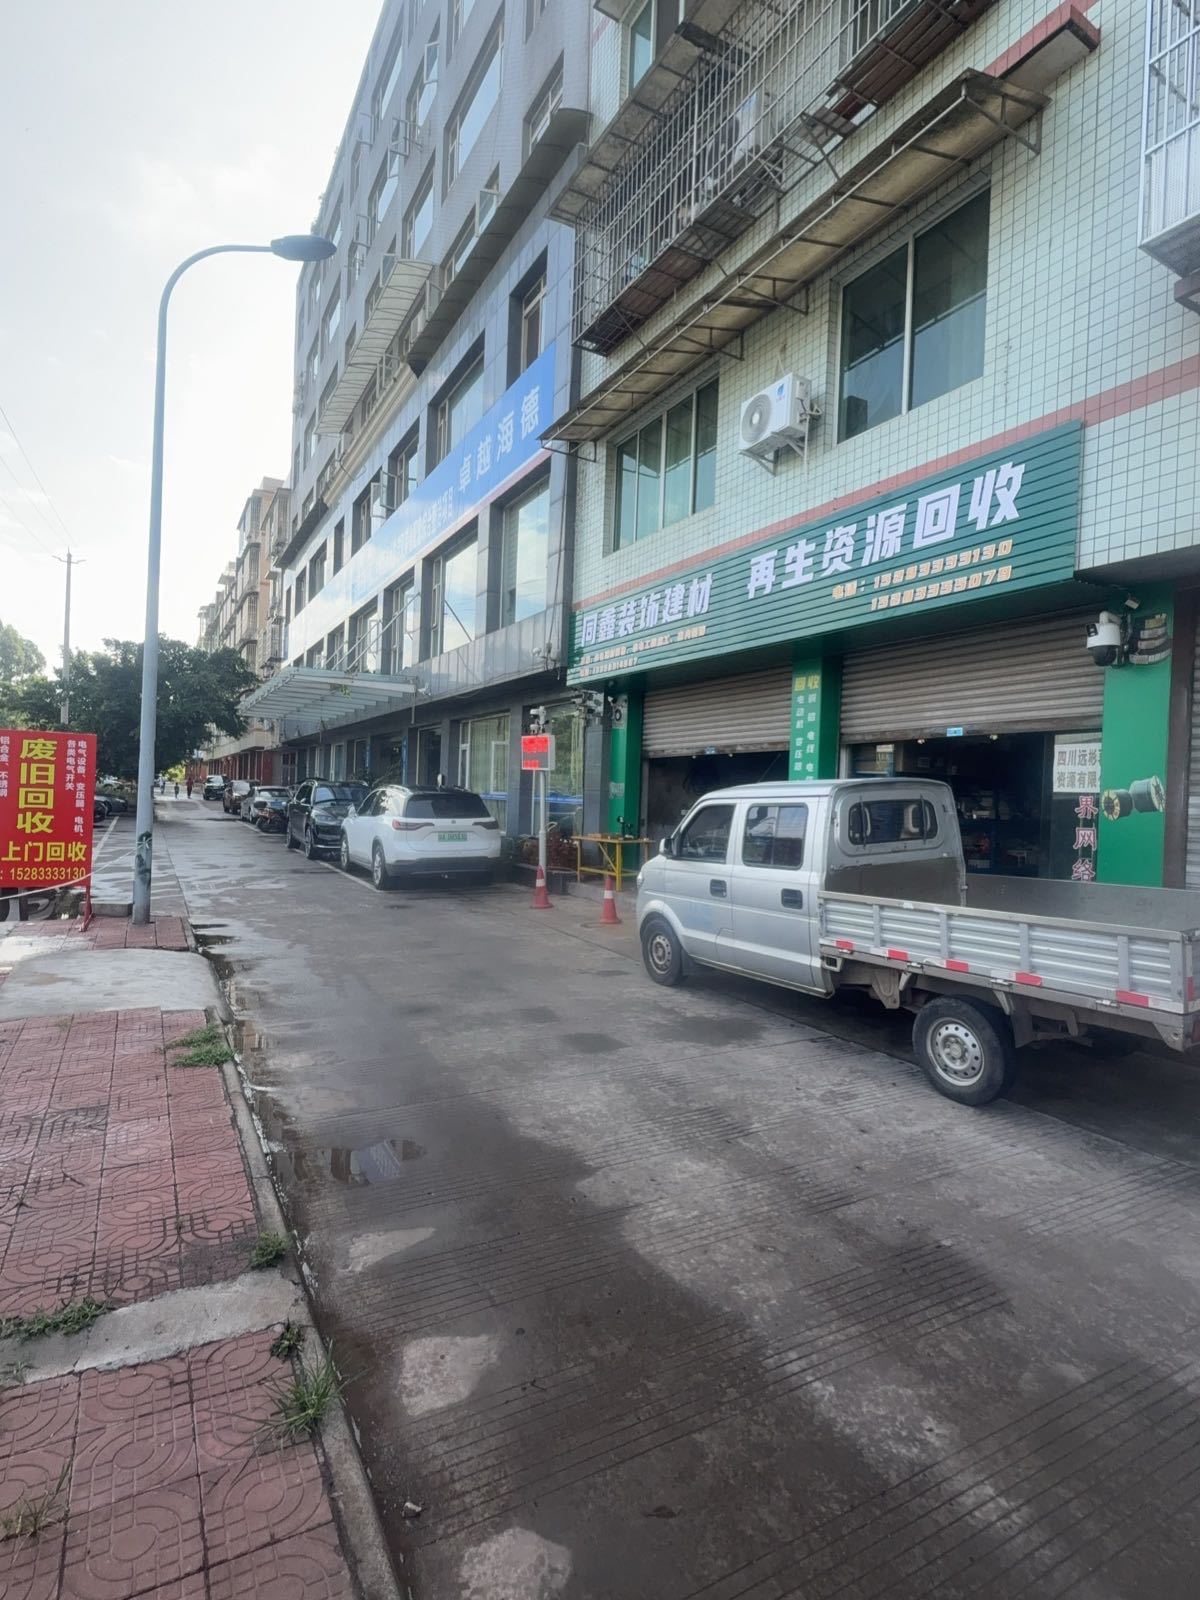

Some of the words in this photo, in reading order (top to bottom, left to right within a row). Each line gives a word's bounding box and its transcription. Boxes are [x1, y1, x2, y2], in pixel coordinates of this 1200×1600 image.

[746, 460, 1026, 599] 再生资源回收
[16, 738, 58, 834] 废旧回收
[1056, 770, 1101, 789] 资源有限
[1, 841, 87, 862] 上门回收
